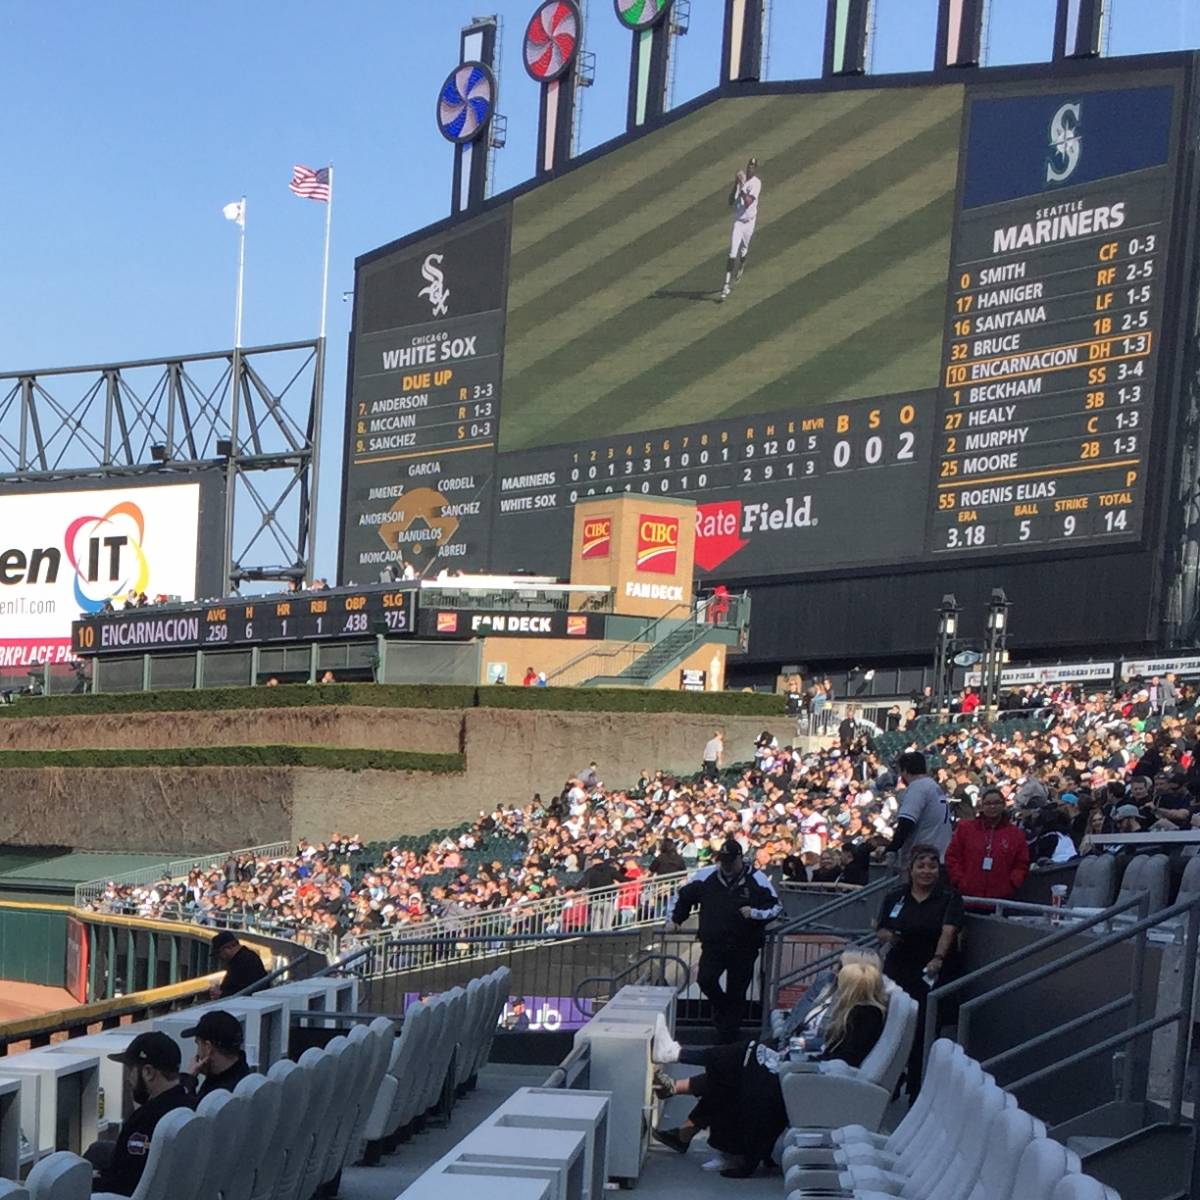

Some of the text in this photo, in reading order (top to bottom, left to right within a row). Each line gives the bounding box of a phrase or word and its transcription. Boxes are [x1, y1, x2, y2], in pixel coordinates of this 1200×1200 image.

[1036, 200, 1083, 219] SEATTLE
[993, 202, 1124, 253] MARINERS
[979, 235, 1155, 285] SMITH CF 0-3
[956, 260, 1152, 312] 17 HANIGER RF 2-5
[954, 285, 1150, 336] 16 SANTANA LF 1-5
[412, 332, 448, 346] CHICAGO
[951, 311, 1148, 360] 32 BRUCE 1B 2-5
[383, 336, 477, 369] WHITE SOX
[950, 336, 1145, 382] 10 ENCARNACION DH 1-3
[403, 370, 452, 391] DUE UP
[969, 361, 1143, 403] BECKHAM SS 3-4
[371, 384, 493, 414] ANDERSON 3-3
[945, 386, 1141, 430] 27 HEALY 3B 1-3
[370, 403, 492, 432] MCCANN 1-3
[837, 415, 849, 433] B
[869, 410, 880, 428] S
[965, 411, 1138, 450] MURPHY 1-3
[369, 422, 490, 450] SANCHEZ 0-3
[834, 432, 915, 468] 0 0 2
[941, 436, 1136, 477] 25 MOORE 2B 1-3
[408, 462, 440, 476] GARCIA
[502, 472, 556, 491] MARINERS
[438, 476, 475, 491] CORDELL
[960, 481, 1056, 507] ROENIS ELIAS
[441, 502, 480, 517] SANCHEZ
[500, 494, 556, 512] WHITE SOX
[939, 493, 955, 509] 55
[1014, 505, 1038, 515] BALL
[1055, 498, 1088, 512] STRIKE
[1099, 493, 1132, 506] TOTAL
[359, 511, 404, 526] ANDERSON
[584, 521, 609, 538] CIBC
[947, 510, 1127, 548] 3.18 5 9 14
[399, 528, 442, 542] BANUELOS
[641, 521, 677, 544] CIBC
[88, 535, 128, 582] IT
[360, 550, 403, 564] MONCADA
[438, 544, 466, 557] ABREU
[207, 594, 403, 622] AVG HR RBI OBP SLG
[78, 618, 198, 647] 10 ENCARNACION
[206, 614, 368, 641] .250 .438
[508, 617, 551, 632] DECK
